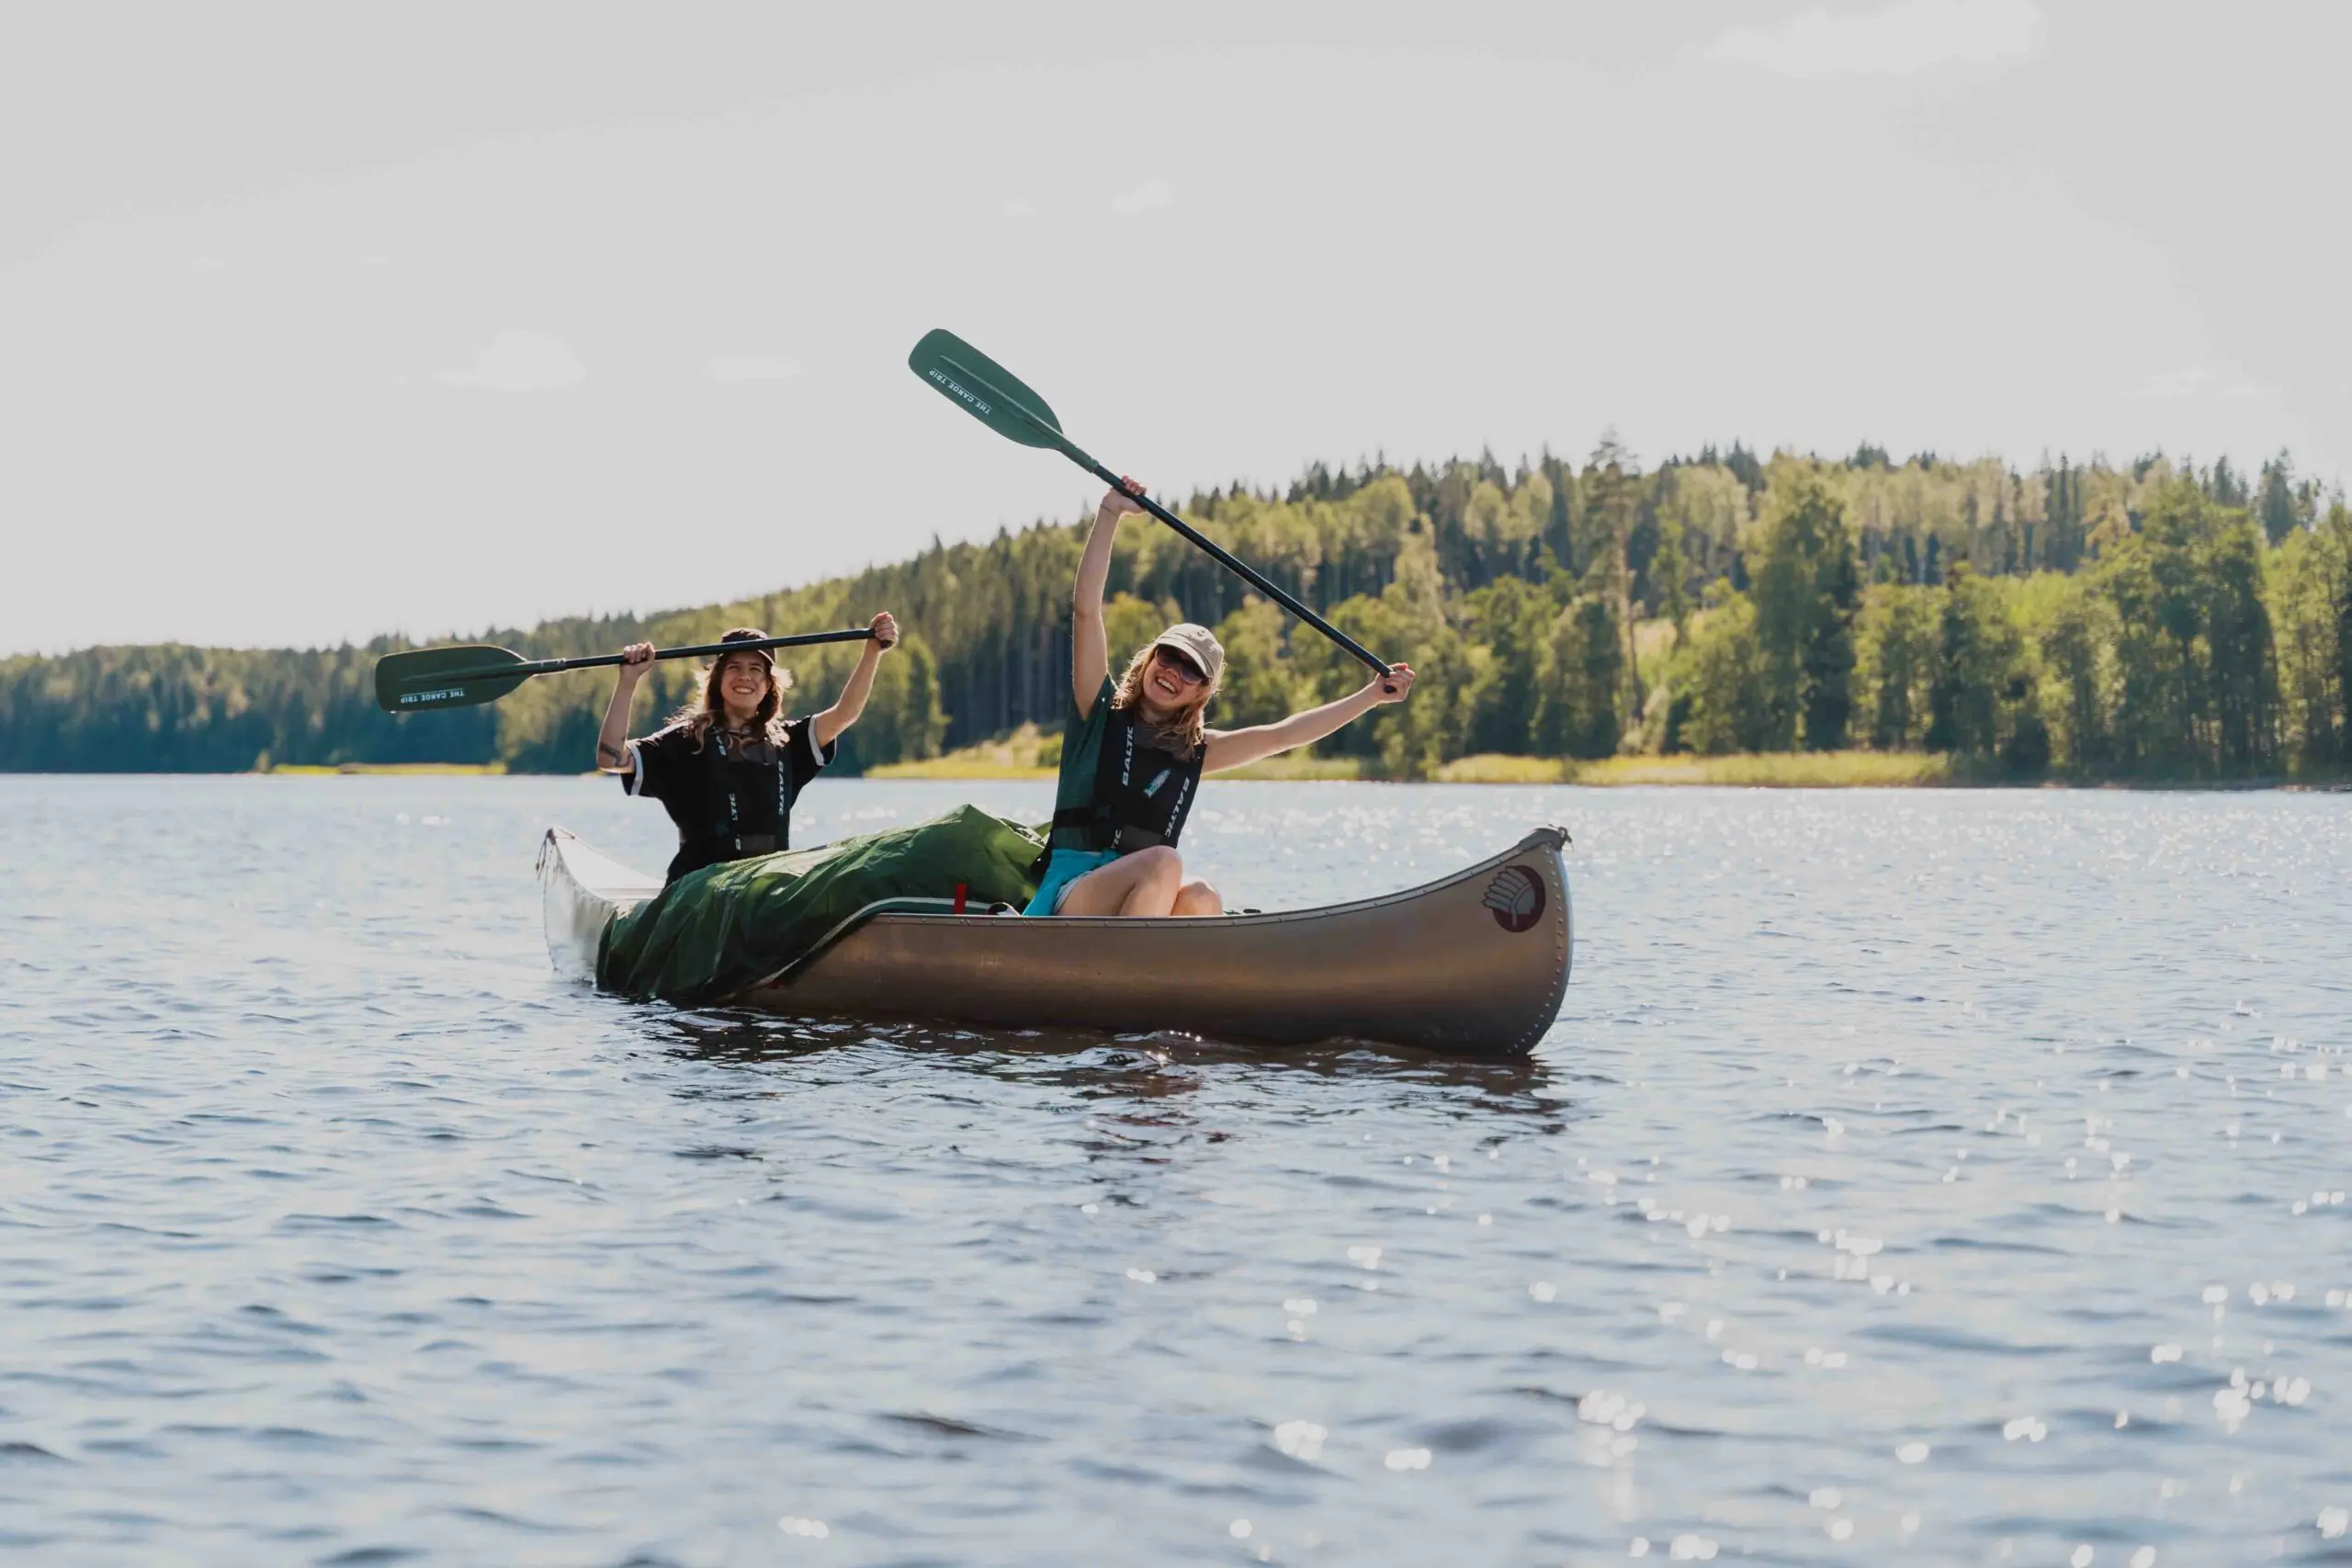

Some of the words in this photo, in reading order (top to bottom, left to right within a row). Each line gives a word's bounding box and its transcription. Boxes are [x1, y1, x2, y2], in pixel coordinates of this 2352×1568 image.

[929, 369, 946, 385] TRIP
[948, 383, 975, 402] CANOE
[975, 402, 991, 414] THE
[401, 695, 419, 705] TRIP
[421, 693, 447, 702] CANOE
[449, 690, 464, 698] THE
[1122, 726, 1134, 787] BALTIC
[1164, 776, 1190, 839] BALTIC
